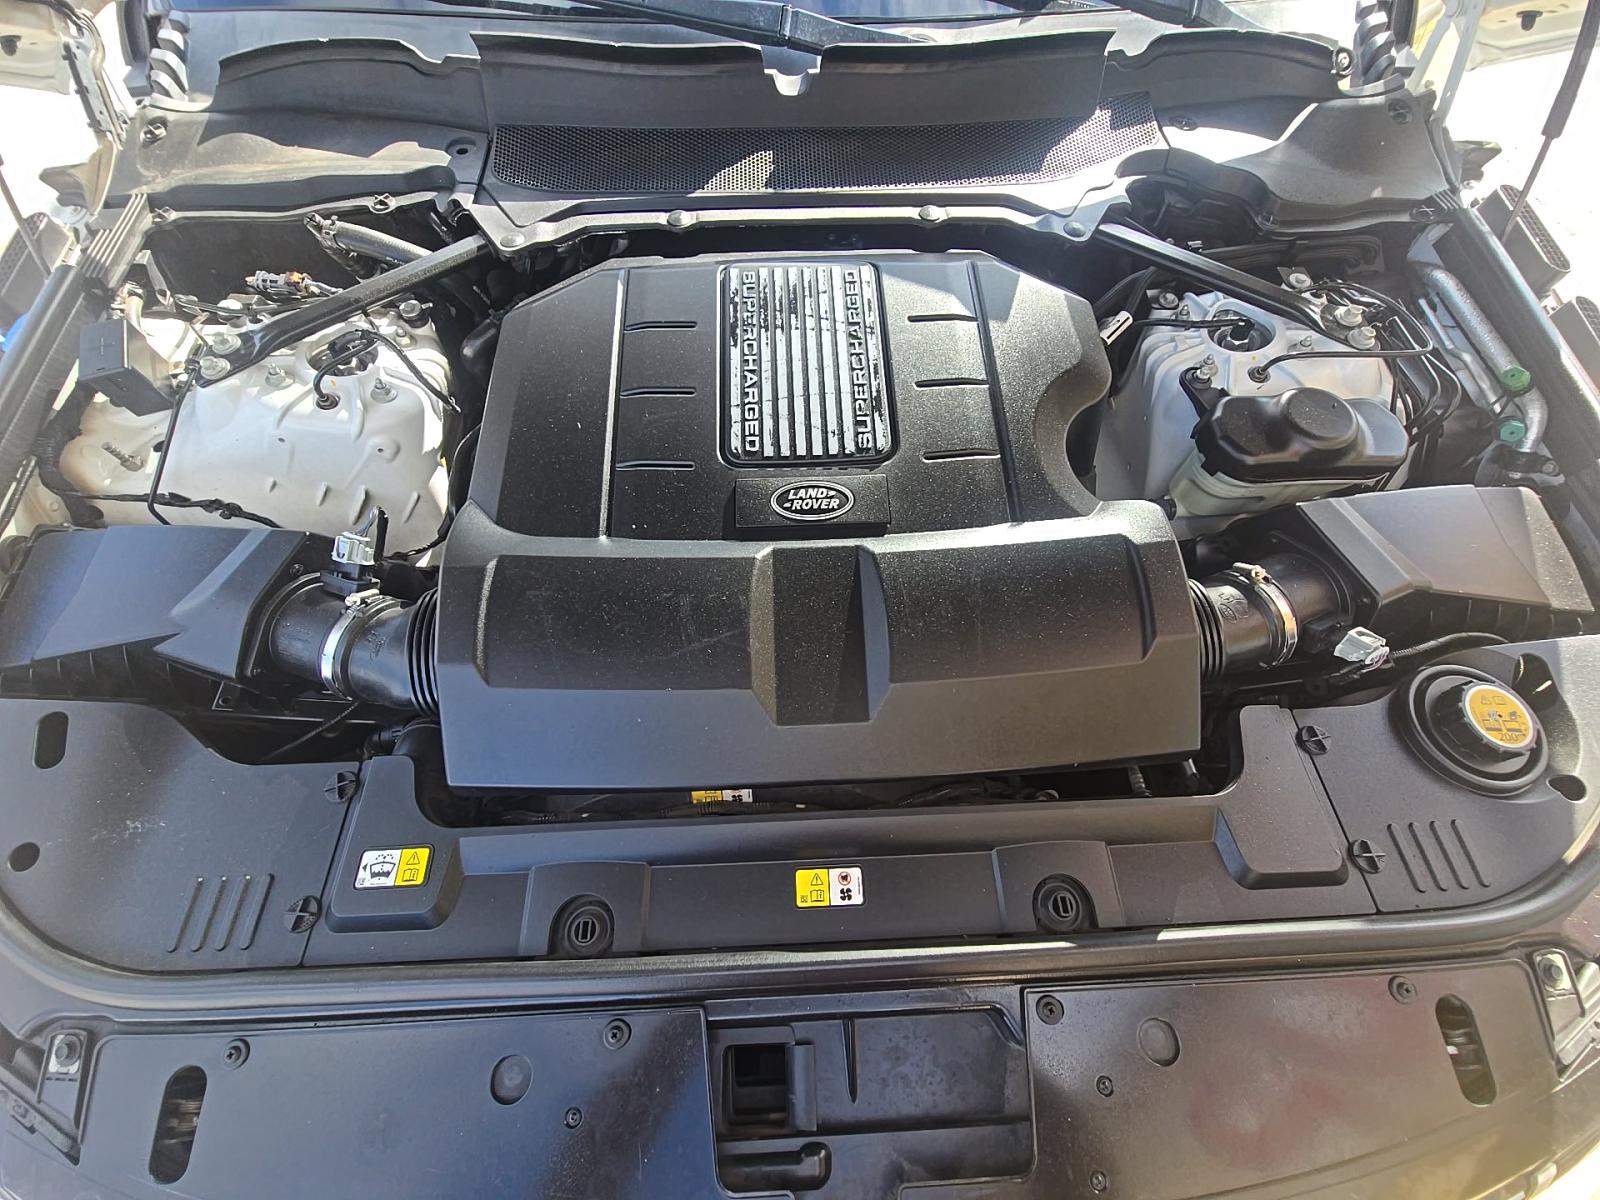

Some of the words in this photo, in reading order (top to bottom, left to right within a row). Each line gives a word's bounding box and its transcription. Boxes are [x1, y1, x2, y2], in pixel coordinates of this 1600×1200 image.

[742, 271, 760, 452] SUPERCHARGED
[844, 270, 873, 449] SUPERCHARGED
[788, 488, 827, 499] LAND
[791, 499, 840, 510] ROVER
